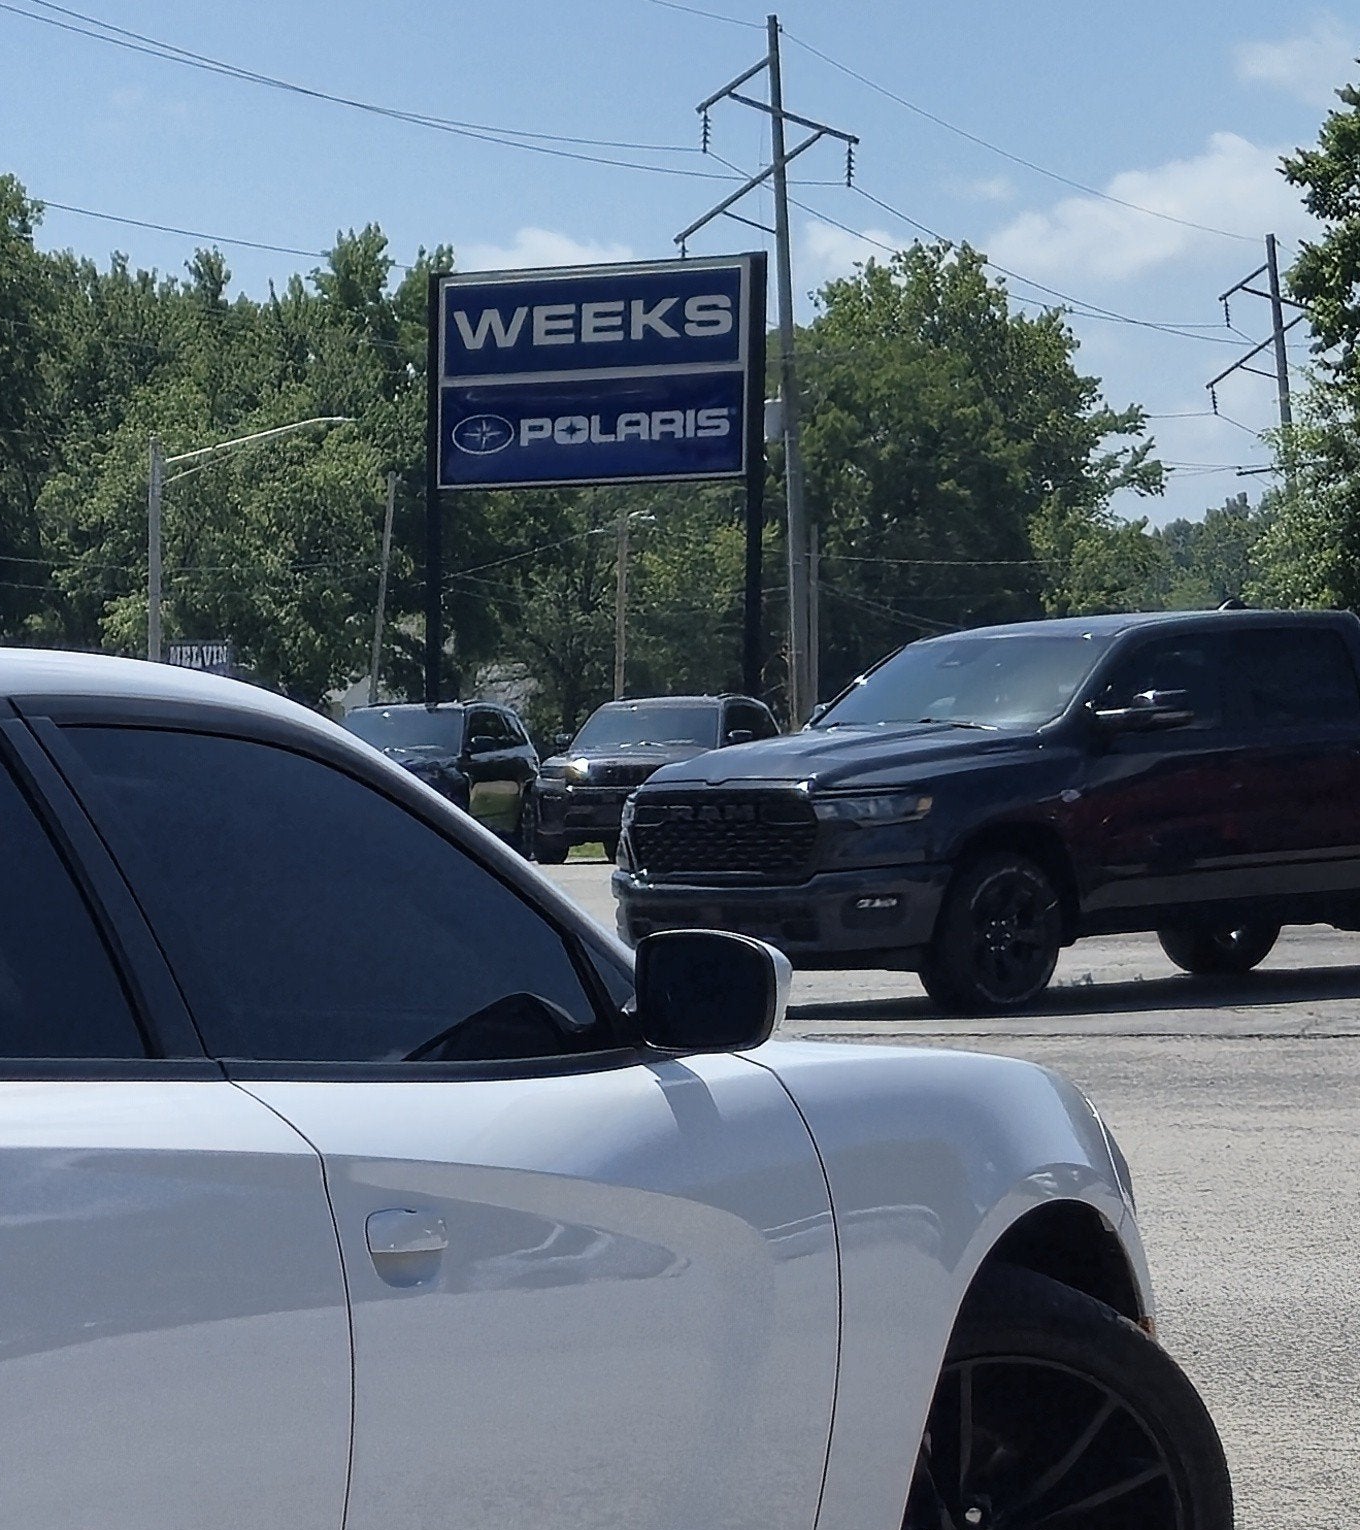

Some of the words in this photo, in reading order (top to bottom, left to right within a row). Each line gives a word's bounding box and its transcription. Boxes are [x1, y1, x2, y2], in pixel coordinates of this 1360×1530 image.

[453, 294, 733, 350] WEEKS
[519, 407, 730, 446] POLARIS
[169, 645, 227, 668] MELVIN
